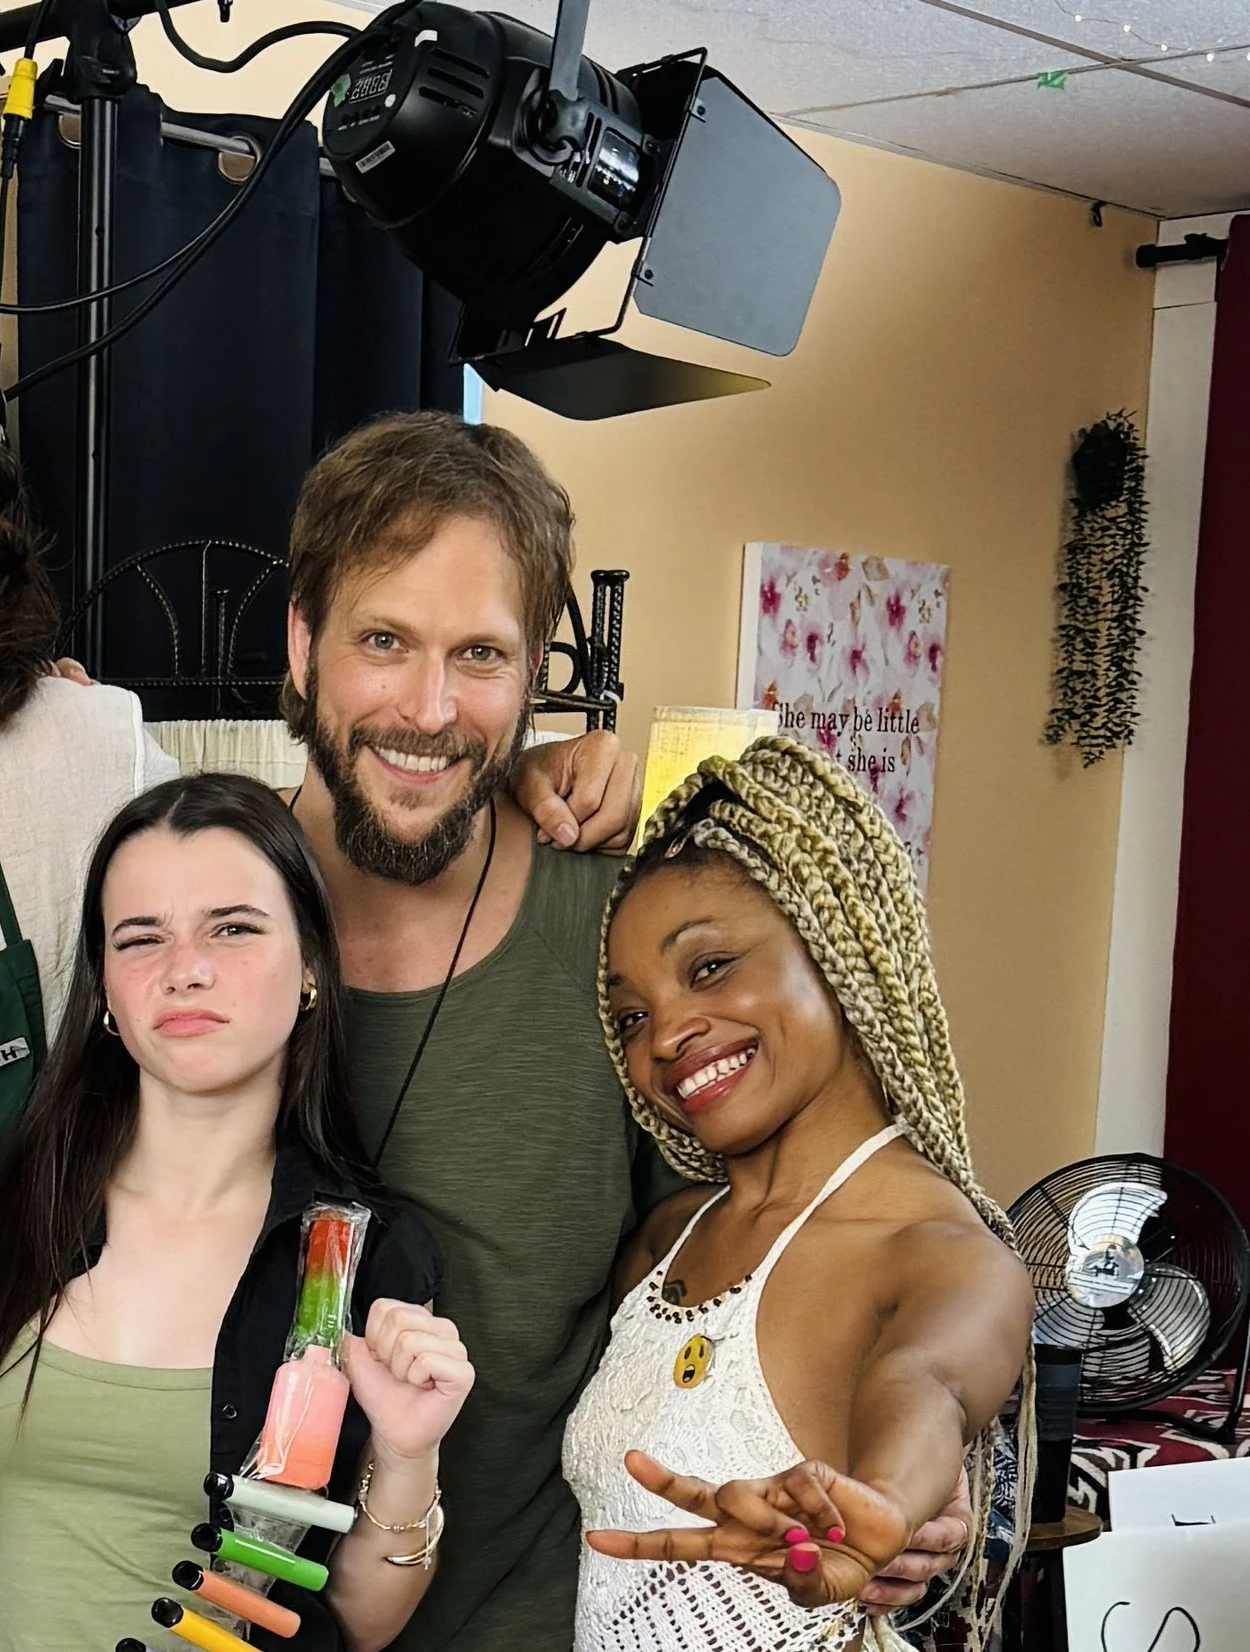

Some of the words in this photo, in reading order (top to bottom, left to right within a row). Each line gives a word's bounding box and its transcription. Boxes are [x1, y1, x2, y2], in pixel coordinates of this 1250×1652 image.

[810, 711, 850, 737] may
[853, 707, 873, 732] be
[877, 707, 919, 734] little
[848, 748, 876, 772] she
[881, 748, 895, 772] is
